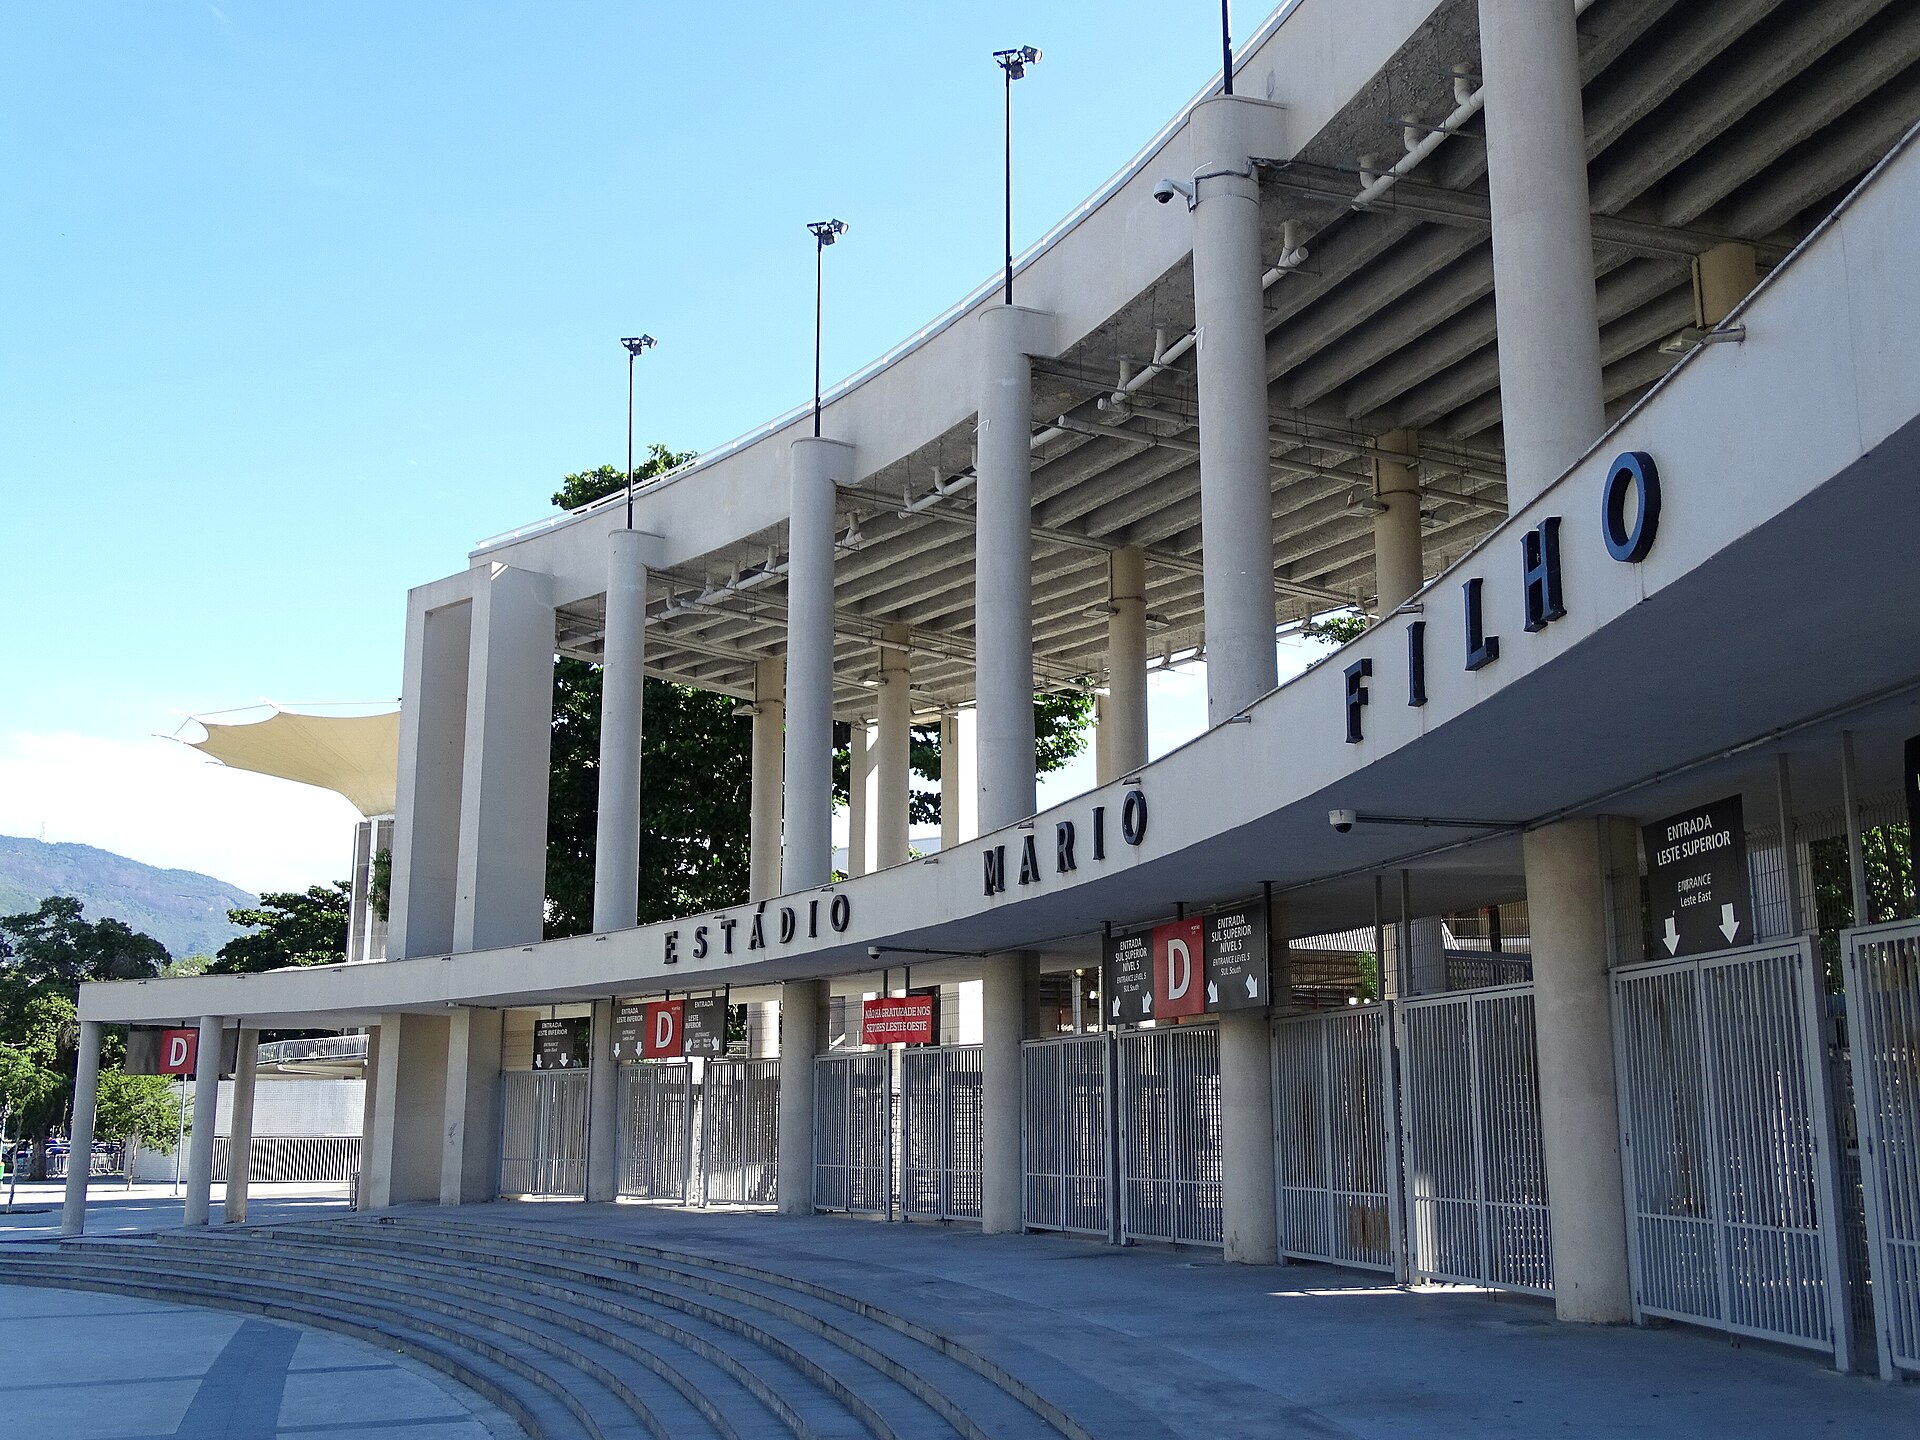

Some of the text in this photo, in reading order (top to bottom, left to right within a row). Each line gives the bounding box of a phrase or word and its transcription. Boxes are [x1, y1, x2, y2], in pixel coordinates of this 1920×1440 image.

[663, 894, 851, 965] ESTÁDIO
[1343, 451, 1661, 744] FILHO
[1667, 814, 1712, 842] ENTRADA
[1657, 830, 1731, 866] LESTE SUPERIOR
[1677, 872, 1712, 893] ENTRANCE
[1680, 890, 1712, 908] Leste East
[1217, 914, 1245, 930] ENTRADA
[1211, 924, 1252, 943] SUL SUPERIOR
[1120, 938, 1142, 951] ENTRADA
[1220, 939, 1242, 953] NÍVEL 5
[1115, 947, 1148, 962] SUL SUPERIOR
[1212, 955, 1234, 967] ENTRANCE
[1122, 960, 1136, 972] NÍVEL
[1167, 938, 1191, 1000] D
[621, 1006, 639, 1015] ENTRADA
[694, 1000, 714, 1009] ENTRADA
[917, 1006, 931, 1016] NOS
[541, 1021, 563, 1029] ENTRADA
[655, 1011, 673, 1049] D
[907, 1020, 927, 1031] OESTE
[169, 1037, 188, 1067] D
